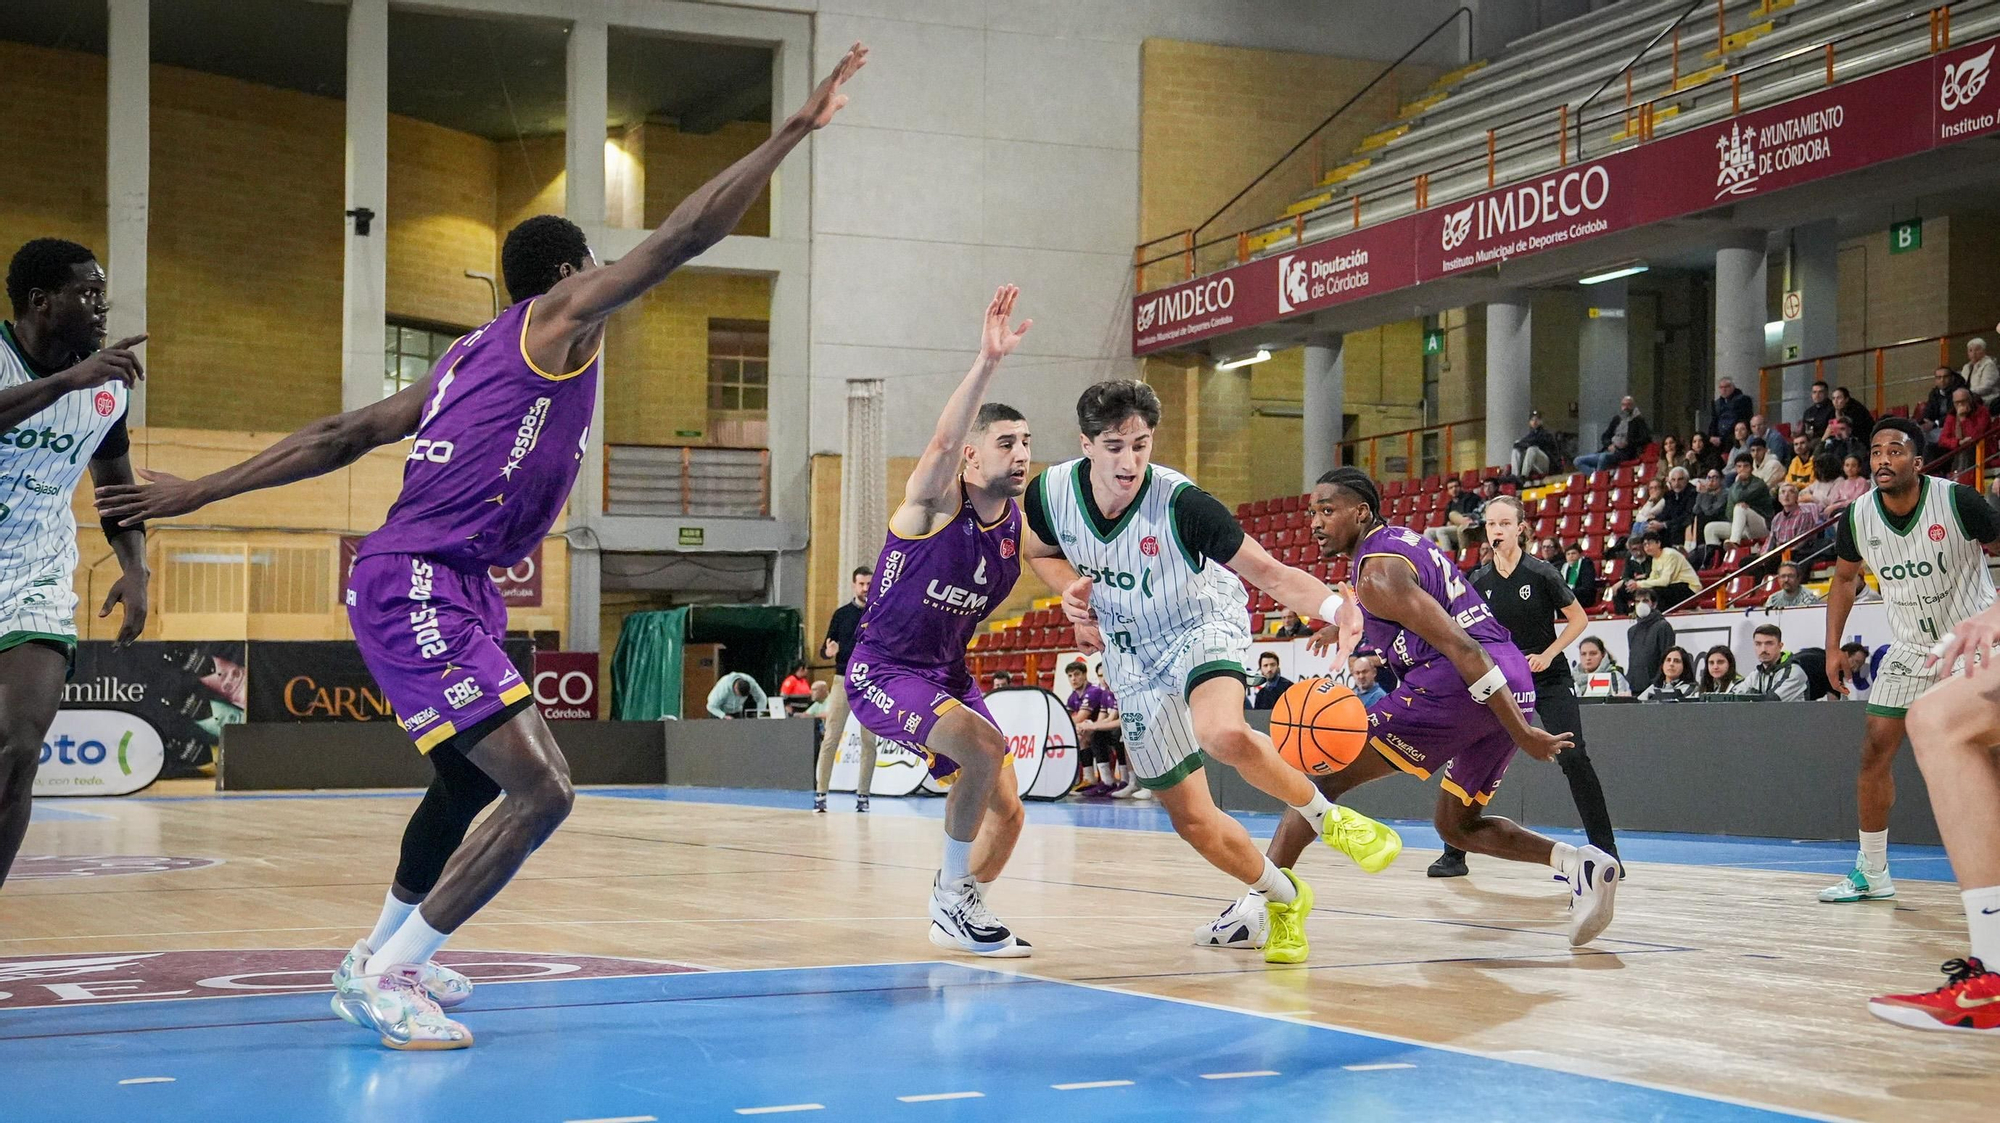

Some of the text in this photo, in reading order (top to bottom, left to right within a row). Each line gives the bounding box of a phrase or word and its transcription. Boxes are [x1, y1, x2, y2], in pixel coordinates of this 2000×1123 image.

[1759, 104, 1844, 150] AYUNTAMIENTO
[1941, 114, 1994, 138] Instituto
[1759, 136, 1831, 176] DE CÓRDOBA
[1478, 165, 1610, 241] IMDECO
[1443, 218, 1608, 272] Instituto Municipal de Deportes Córdoba
[1898, 225, 1912, 248] B
[1311, 248, 1369, 280] Diputación
[1311, 270, 1369, 299] de Córdoba
[1158, 277, 1235, 326] IMDECO
[1428, 334, 1438, 351] A
[25, 475, 62, 496] Cajasol
[1880, 559, 1933, 581] coto
[1919, 616, 1939, 641] 4
[443, 676, 480, 705] CBC
[544, 707, 590, 719] Córdoba
